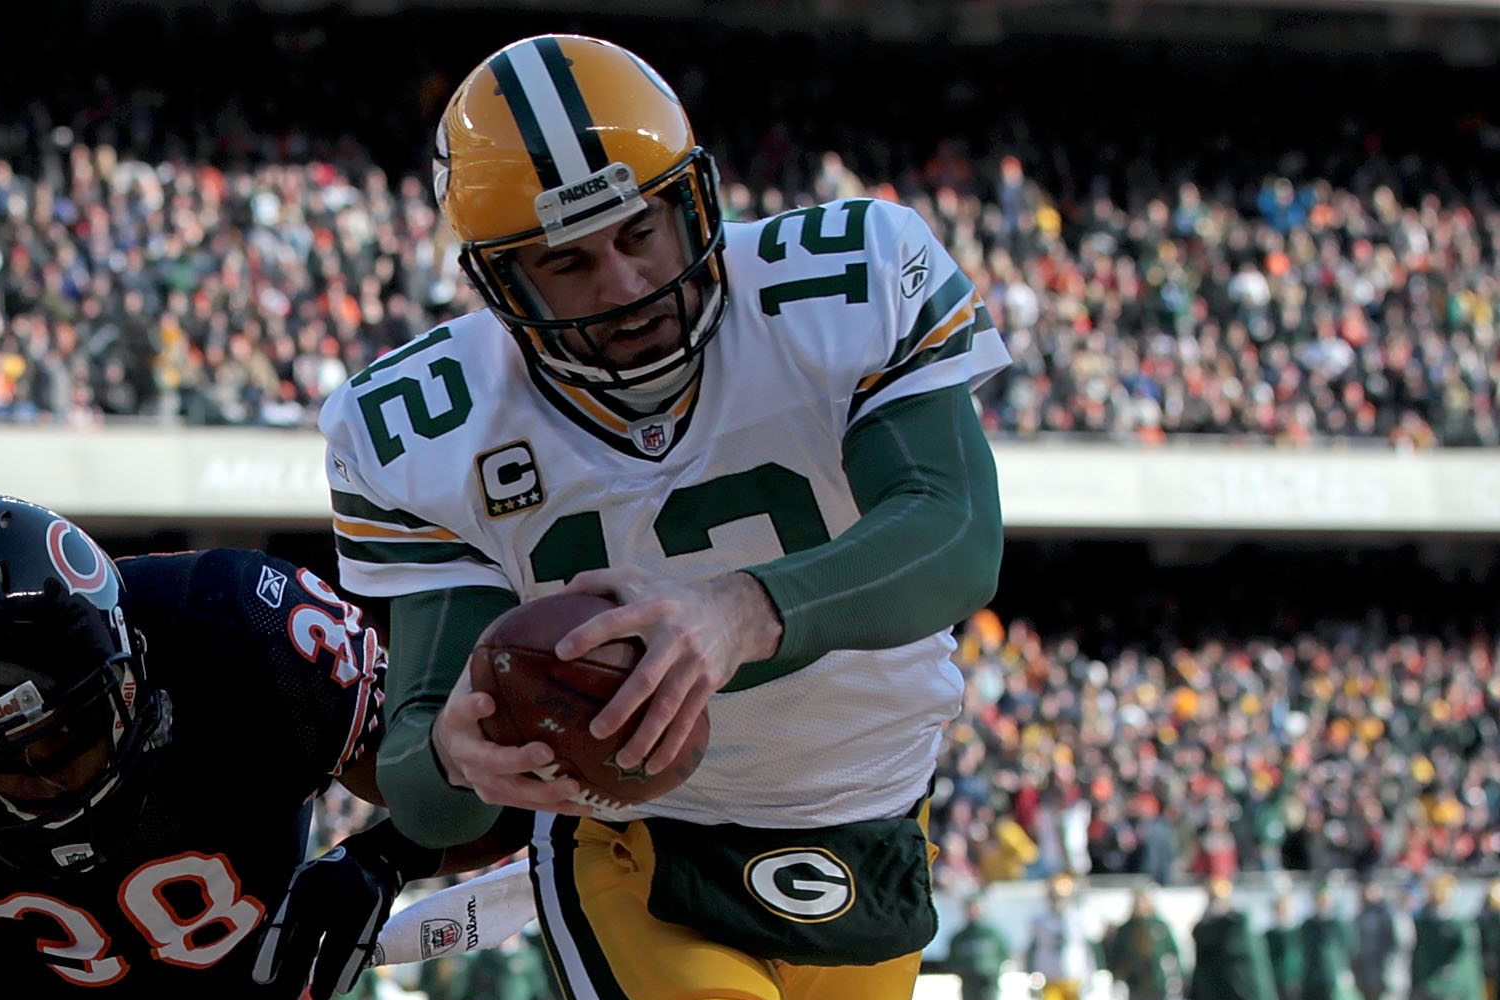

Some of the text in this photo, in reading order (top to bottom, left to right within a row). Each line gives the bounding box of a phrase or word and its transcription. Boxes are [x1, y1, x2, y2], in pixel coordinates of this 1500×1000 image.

[558, 175, 609, 206] PACKERS
[758, 199, 869, 317] 12
[350, 326, 473, 467] 12
[481, 447, 537, 501] C
[750, 851, 848, 916] G
[466, 896, 479, 951] Wilson
